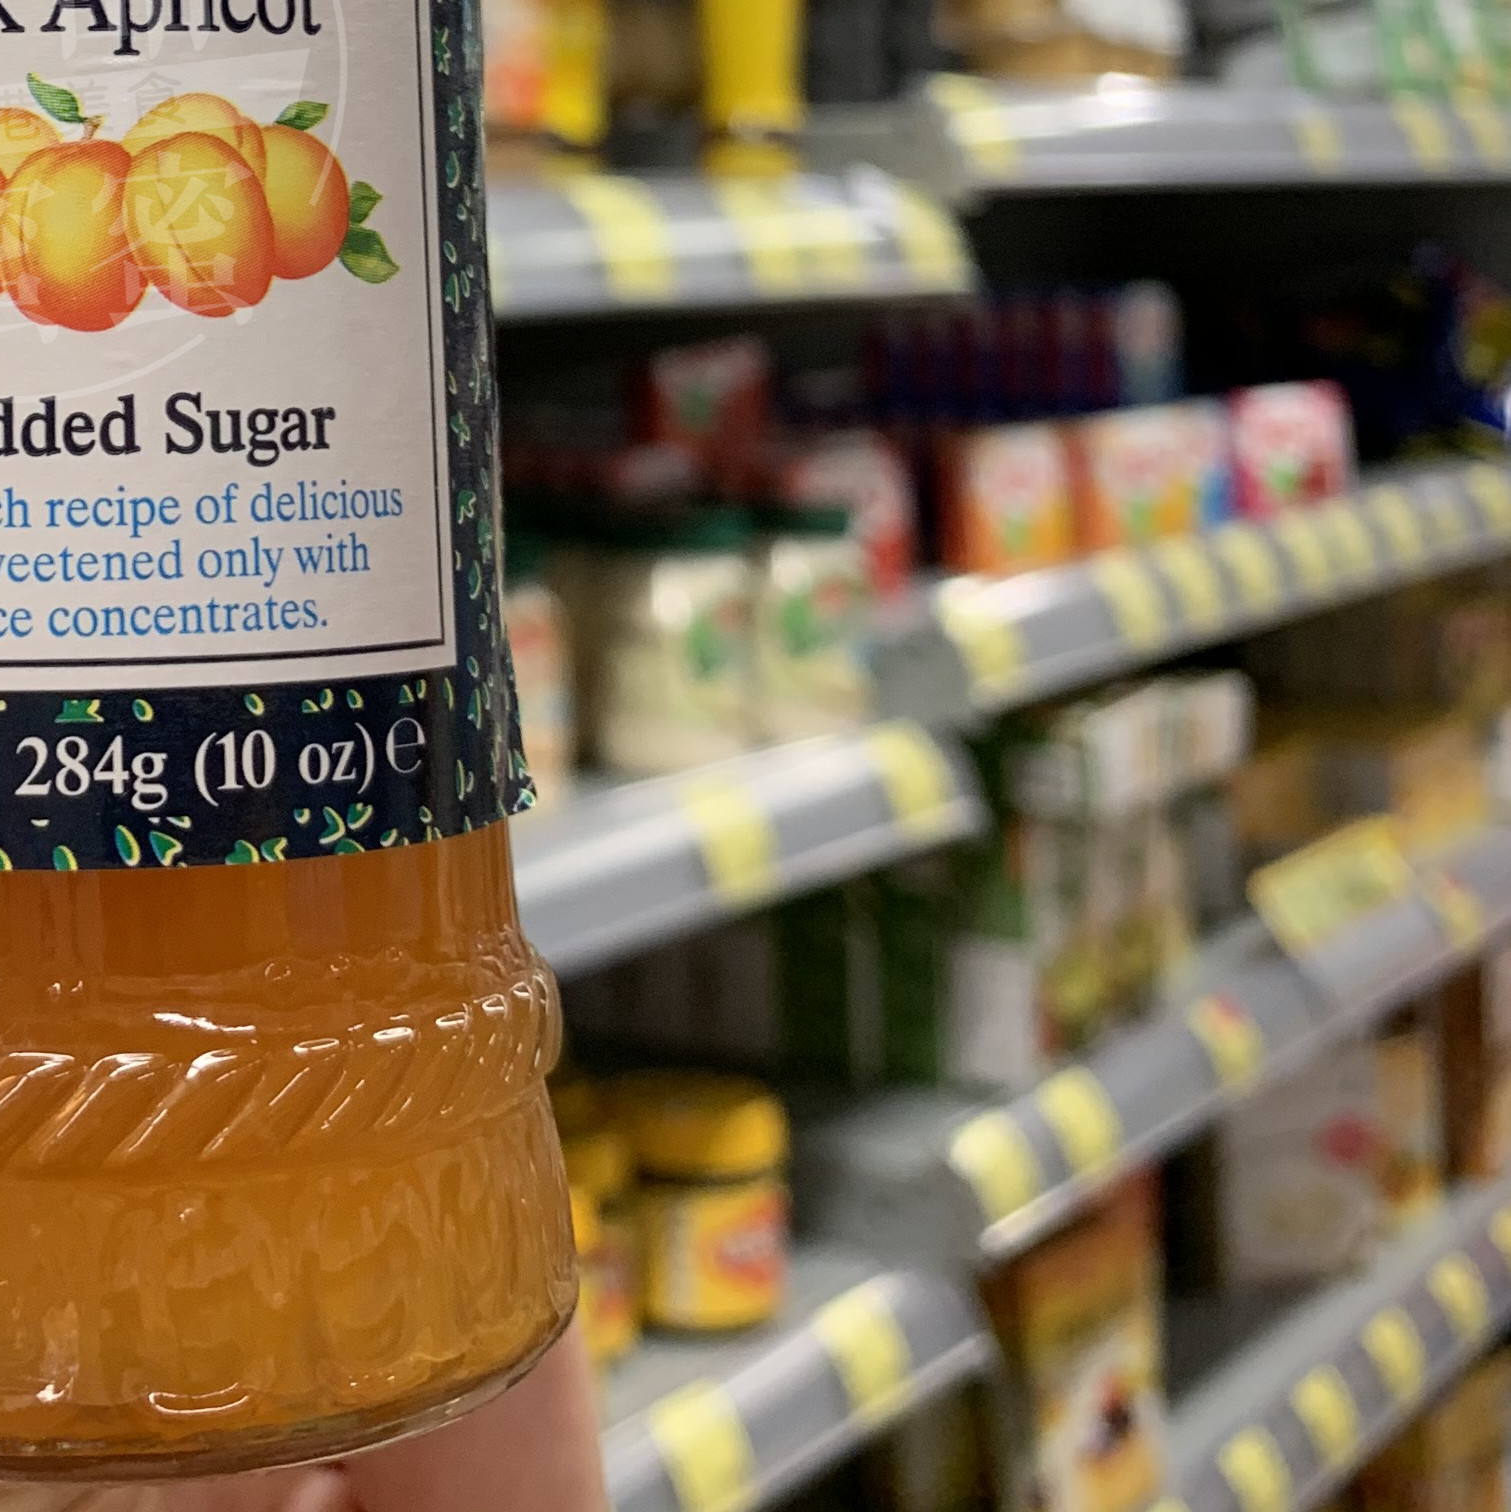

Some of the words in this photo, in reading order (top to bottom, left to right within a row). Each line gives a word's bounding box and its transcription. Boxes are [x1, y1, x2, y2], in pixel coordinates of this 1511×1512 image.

[164, 391, 337, 468] Sugar
[45, 486, 182, 538] recipe
[193, 483, 239, 525] of
[248, 480, 403, 524] delicious
[196, 535, 284, 588] only
[293, 533, 371, 575] with
[46, 595, 330, 638] concentrates.
[13, 734, 169, 811] 284g
[193, 728, 277, 807] (10
[298, 722, 375, 794] oz)
